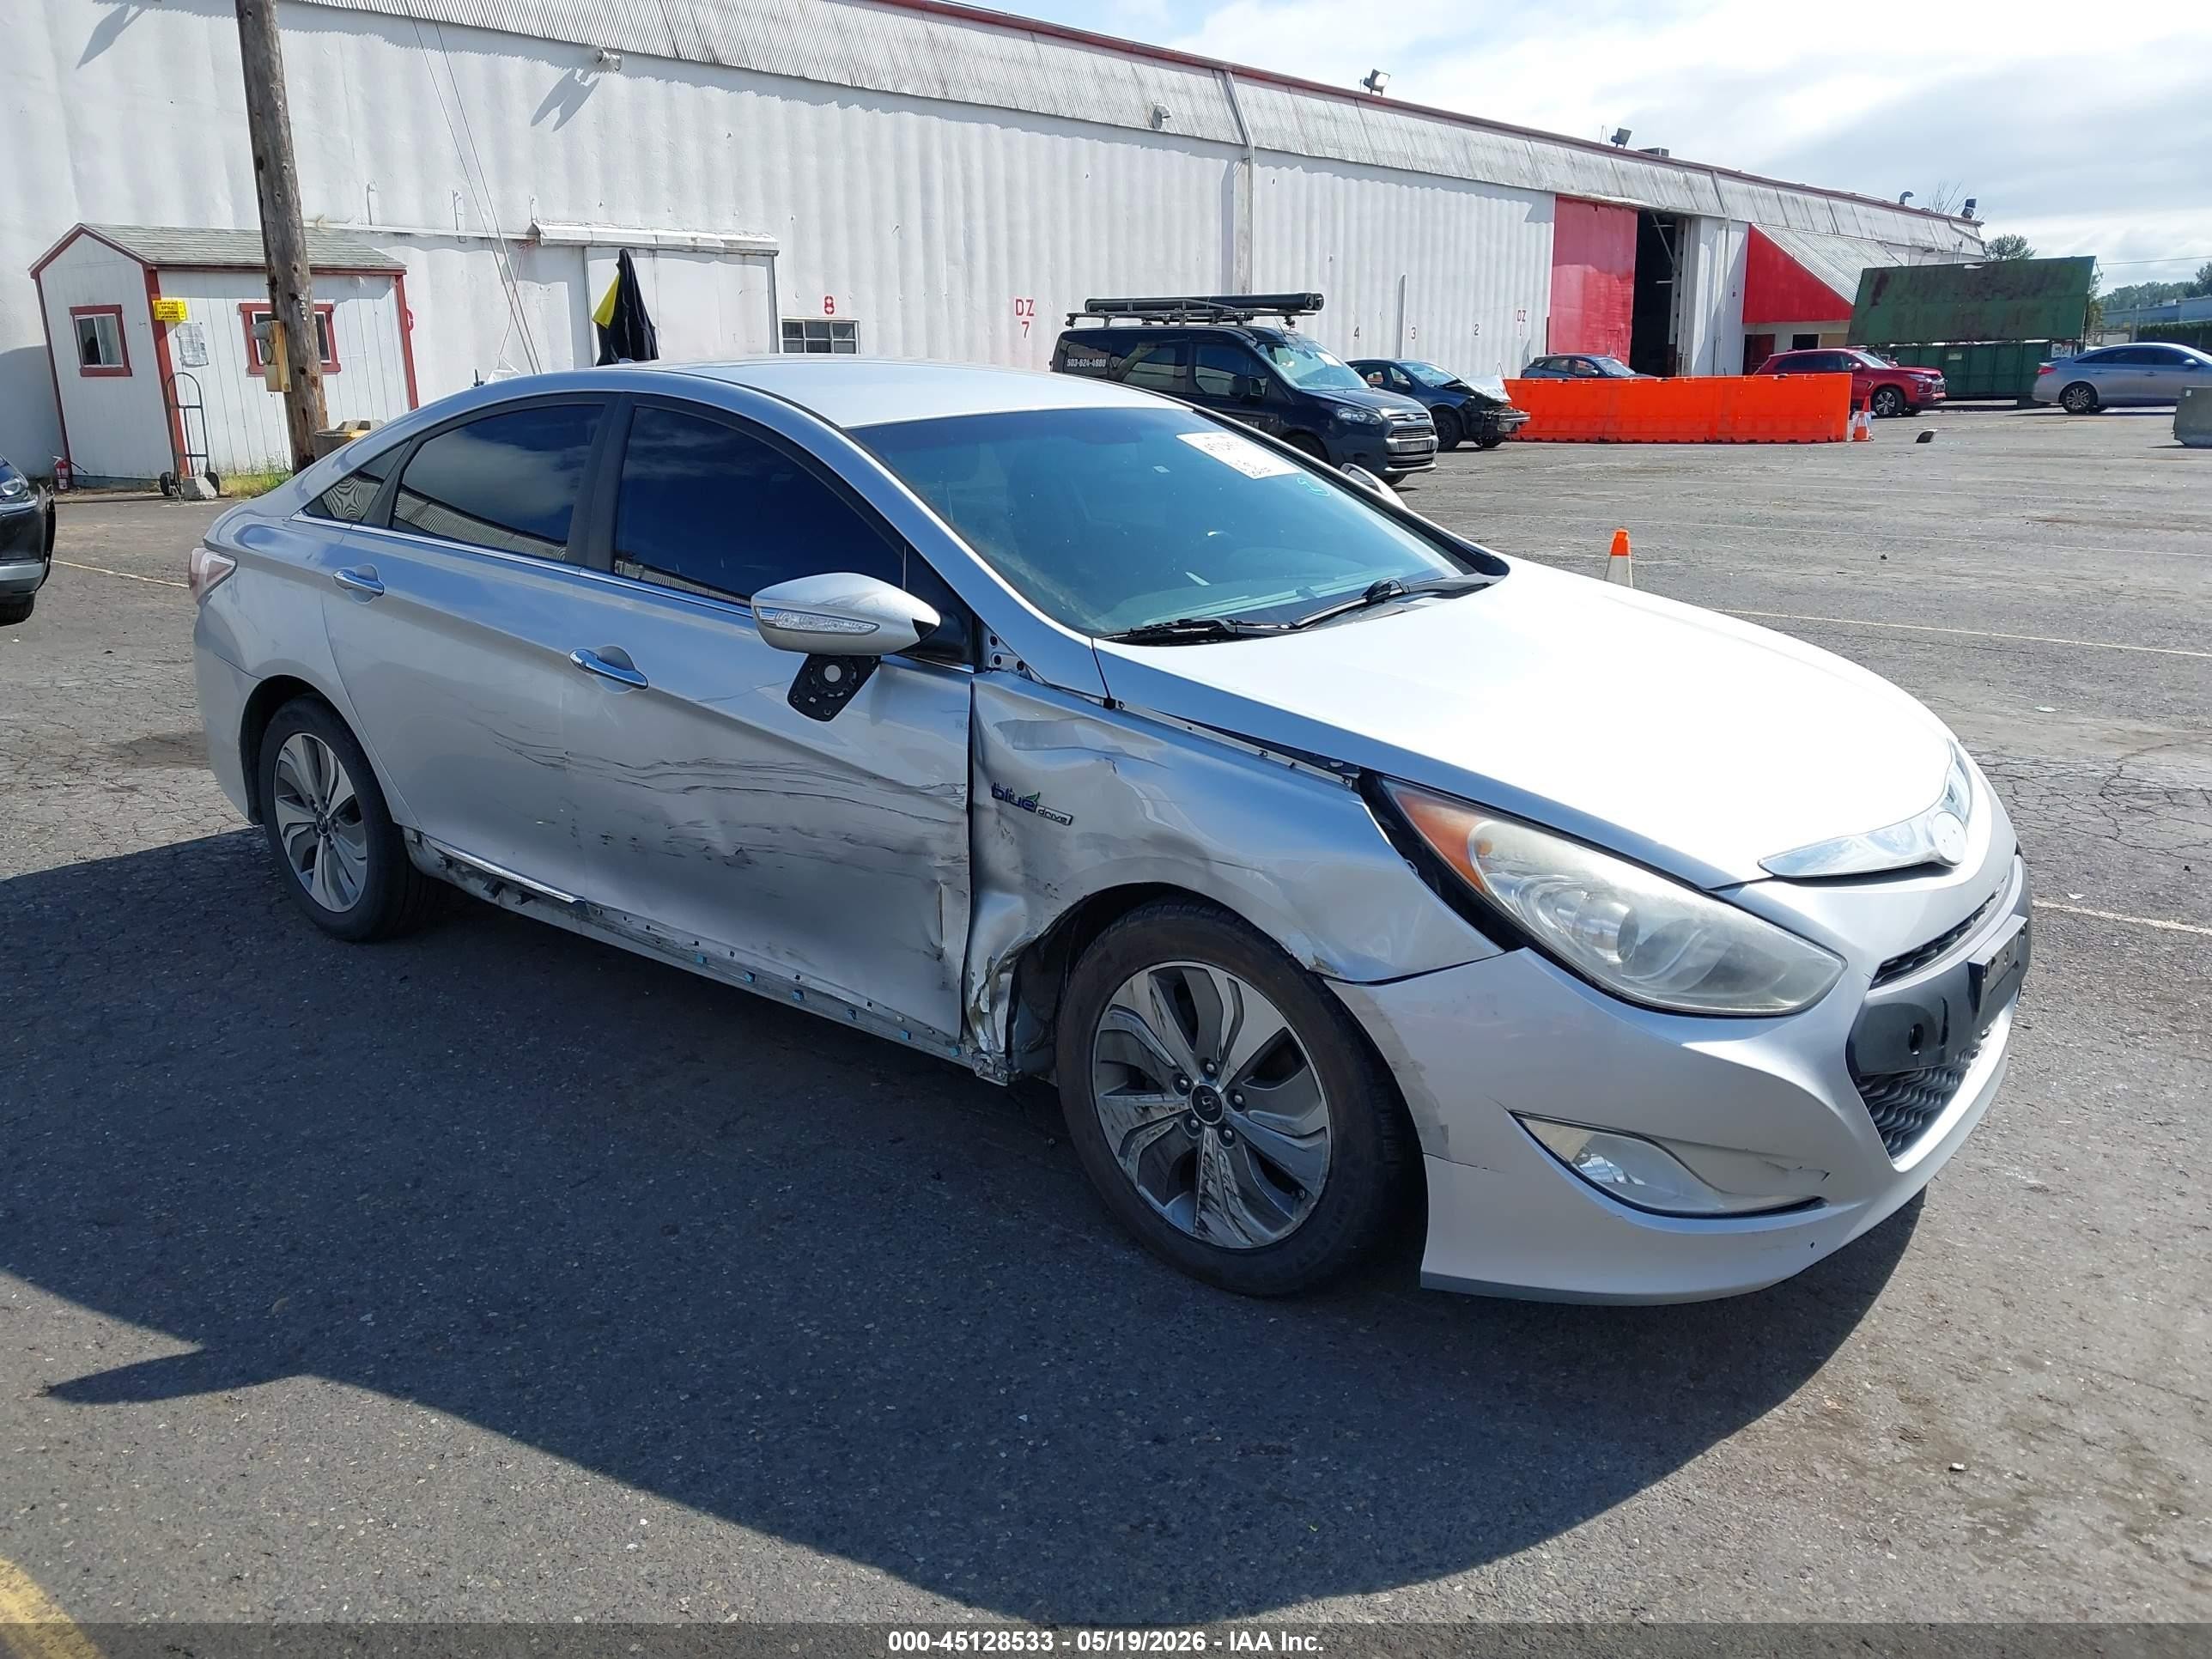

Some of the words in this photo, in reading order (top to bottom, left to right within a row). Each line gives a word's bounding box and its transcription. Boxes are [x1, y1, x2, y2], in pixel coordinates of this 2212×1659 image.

[824, 295, 835, 315] 8
[1015, 298, 1035, 316] DZ
[1516, 309, 1527, 323] DZ
[1021, 321, 1030, 338] 7
[1353, 325, 1360, 341] 4
[1411, 326, 1417, 340] 3
[1474, 323, 1480, 337] 2
[990, 782, 1038, 813] blue
[1036, 806, 1071, 825] drive
